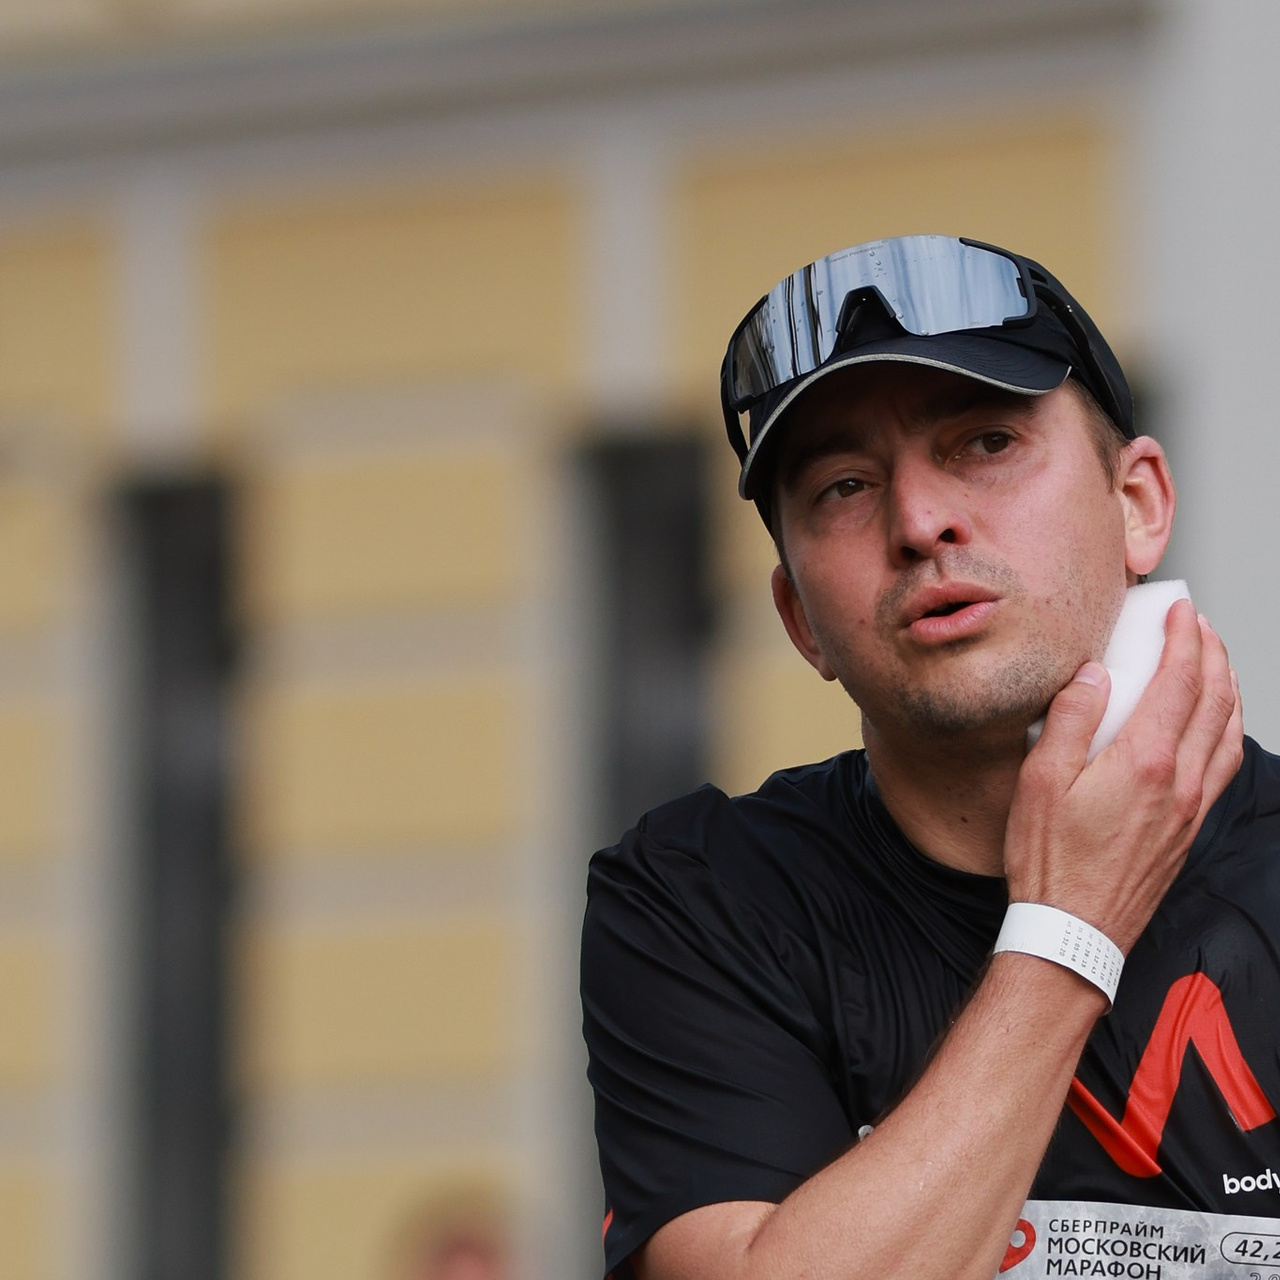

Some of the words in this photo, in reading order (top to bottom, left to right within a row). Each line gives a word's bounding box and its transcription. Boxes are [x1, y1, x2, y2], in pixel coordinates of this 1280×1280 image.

[1049, 1219, 1164, 1239] СБЕРПРАЙМ
[1047, 1237, 1206, 1265] МОСКОВСКИЙ
[1046, 1259, 1162, 1280] МАРАФОН
